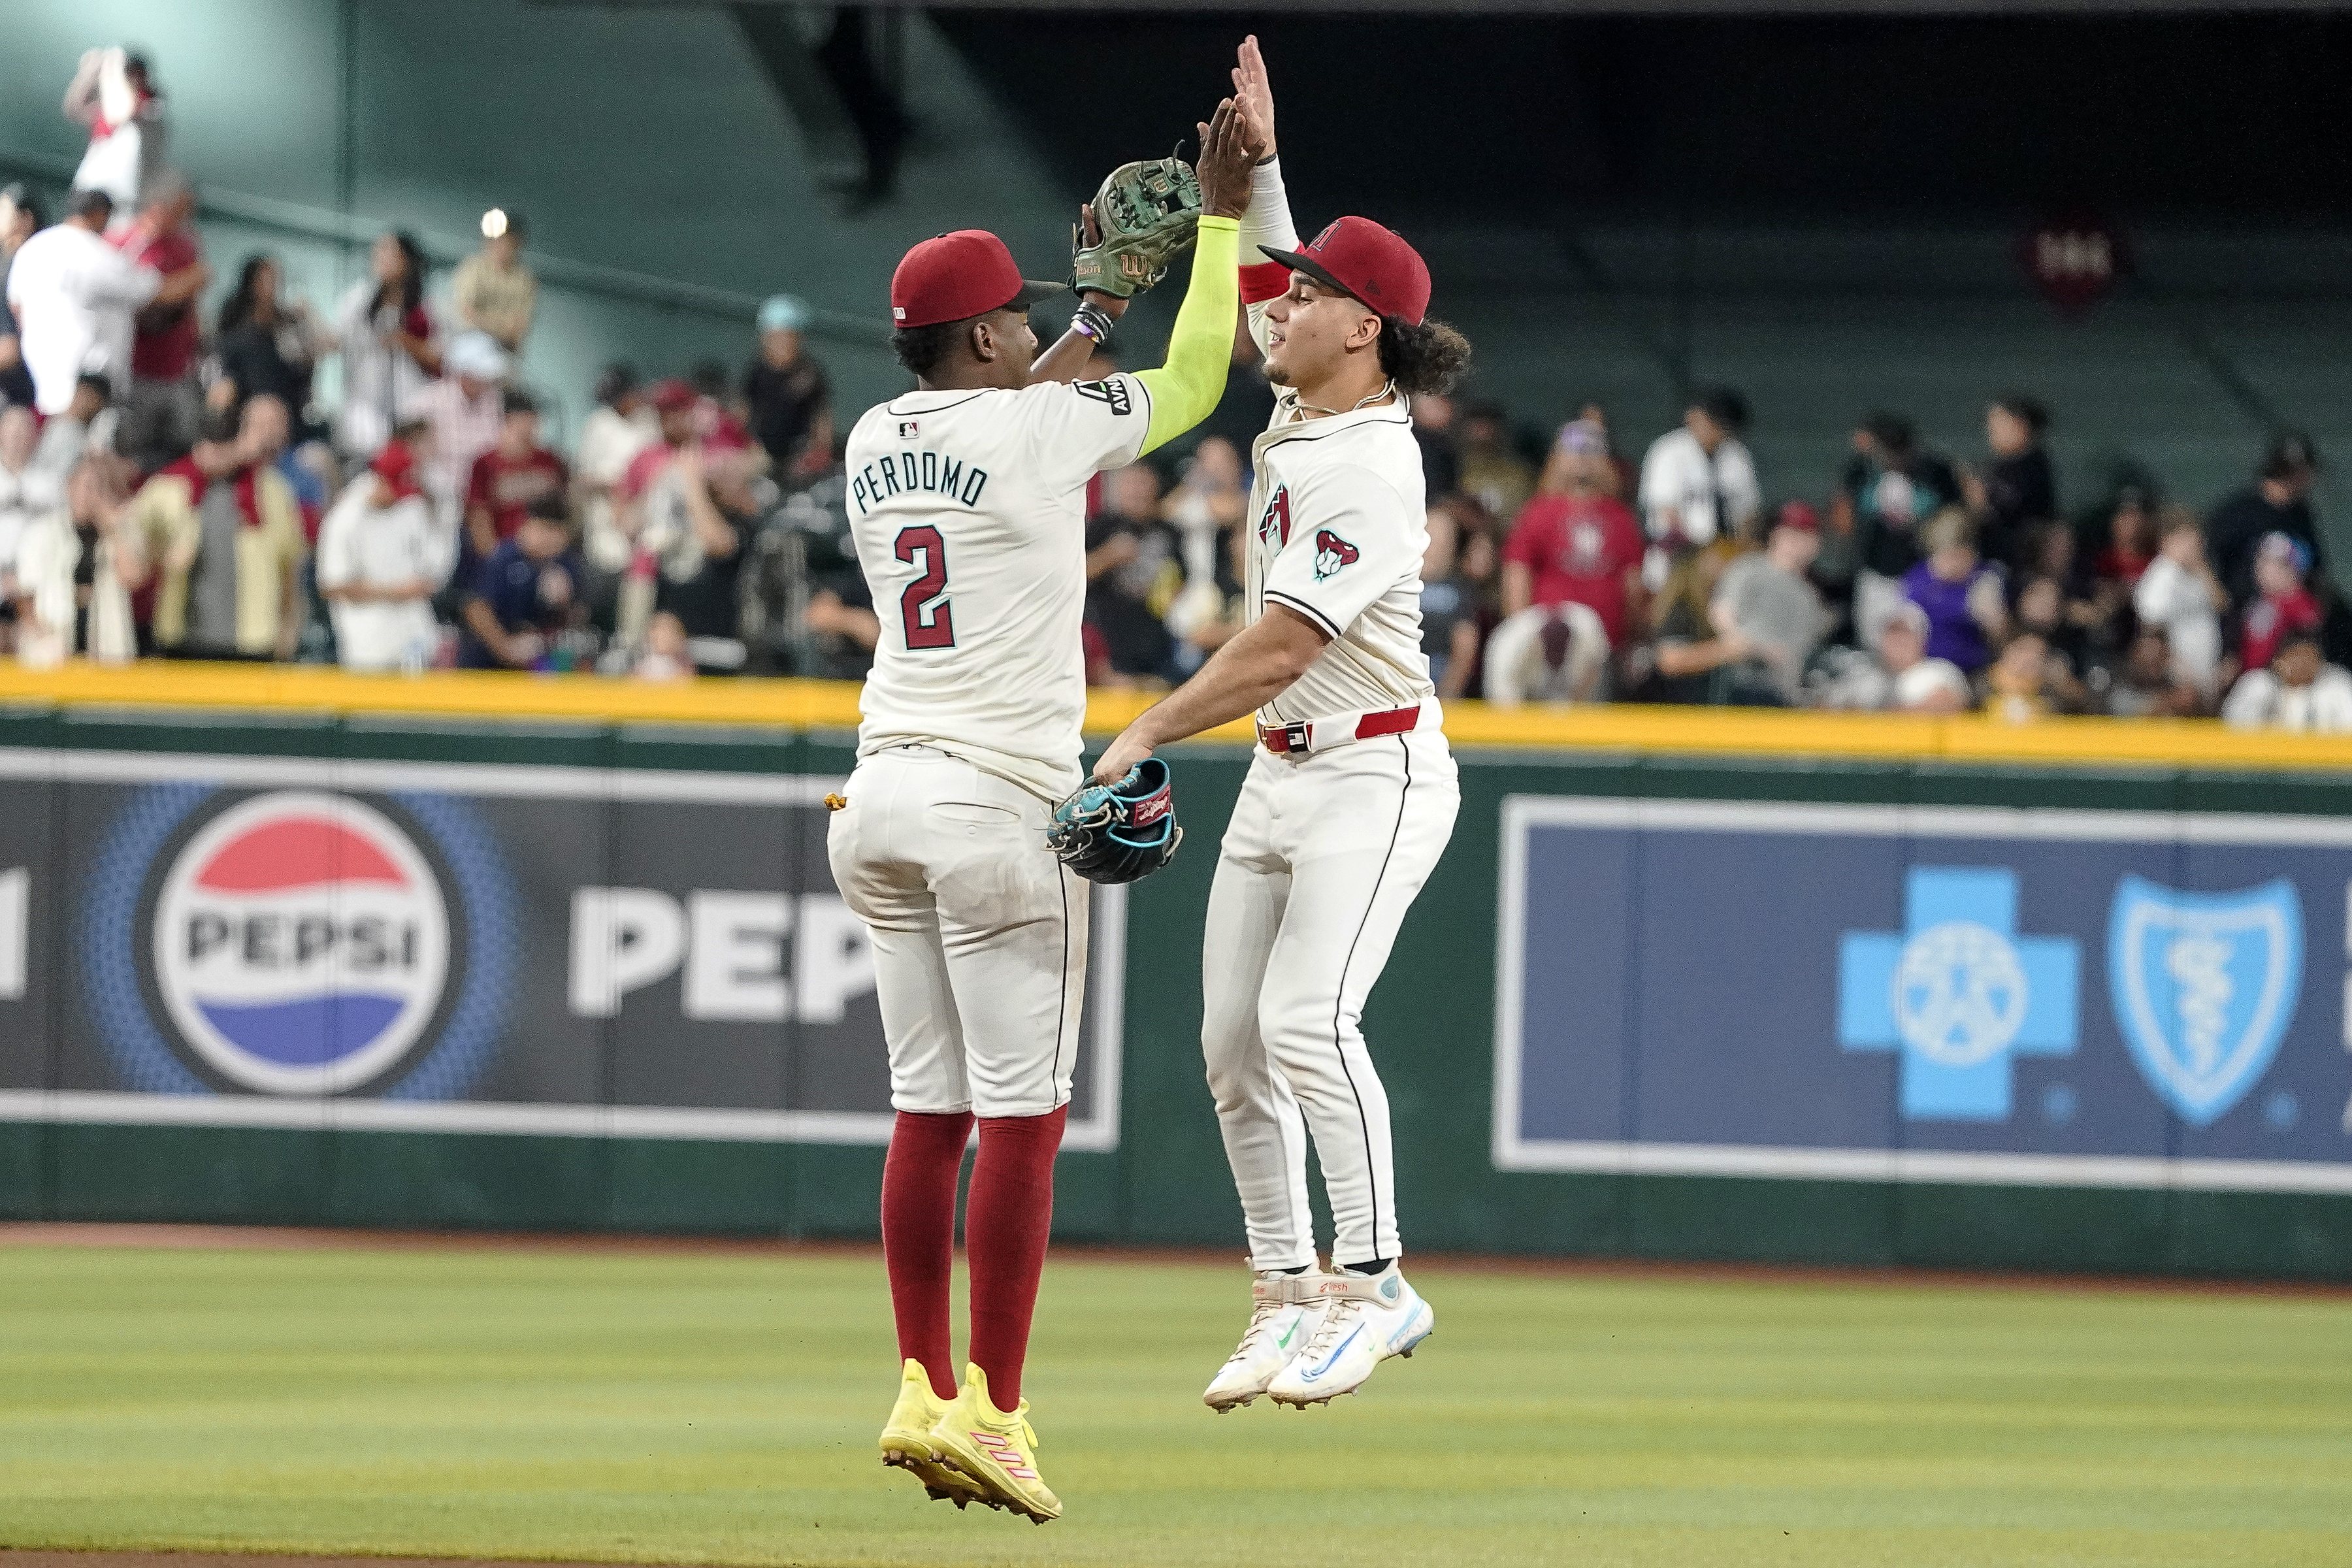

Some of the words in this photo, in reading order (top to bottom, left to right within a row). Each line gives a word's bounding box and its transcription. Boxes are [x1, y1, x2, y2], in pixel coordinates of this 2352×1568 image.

[1107, 380, 1130, 412] AVN
[852, 451, 988, 515] PERDOMO
[894, 524, 958, 651] 2
[186, 909, 421, 971] PEPSI
[568, 885, 875, 1024] PEP
